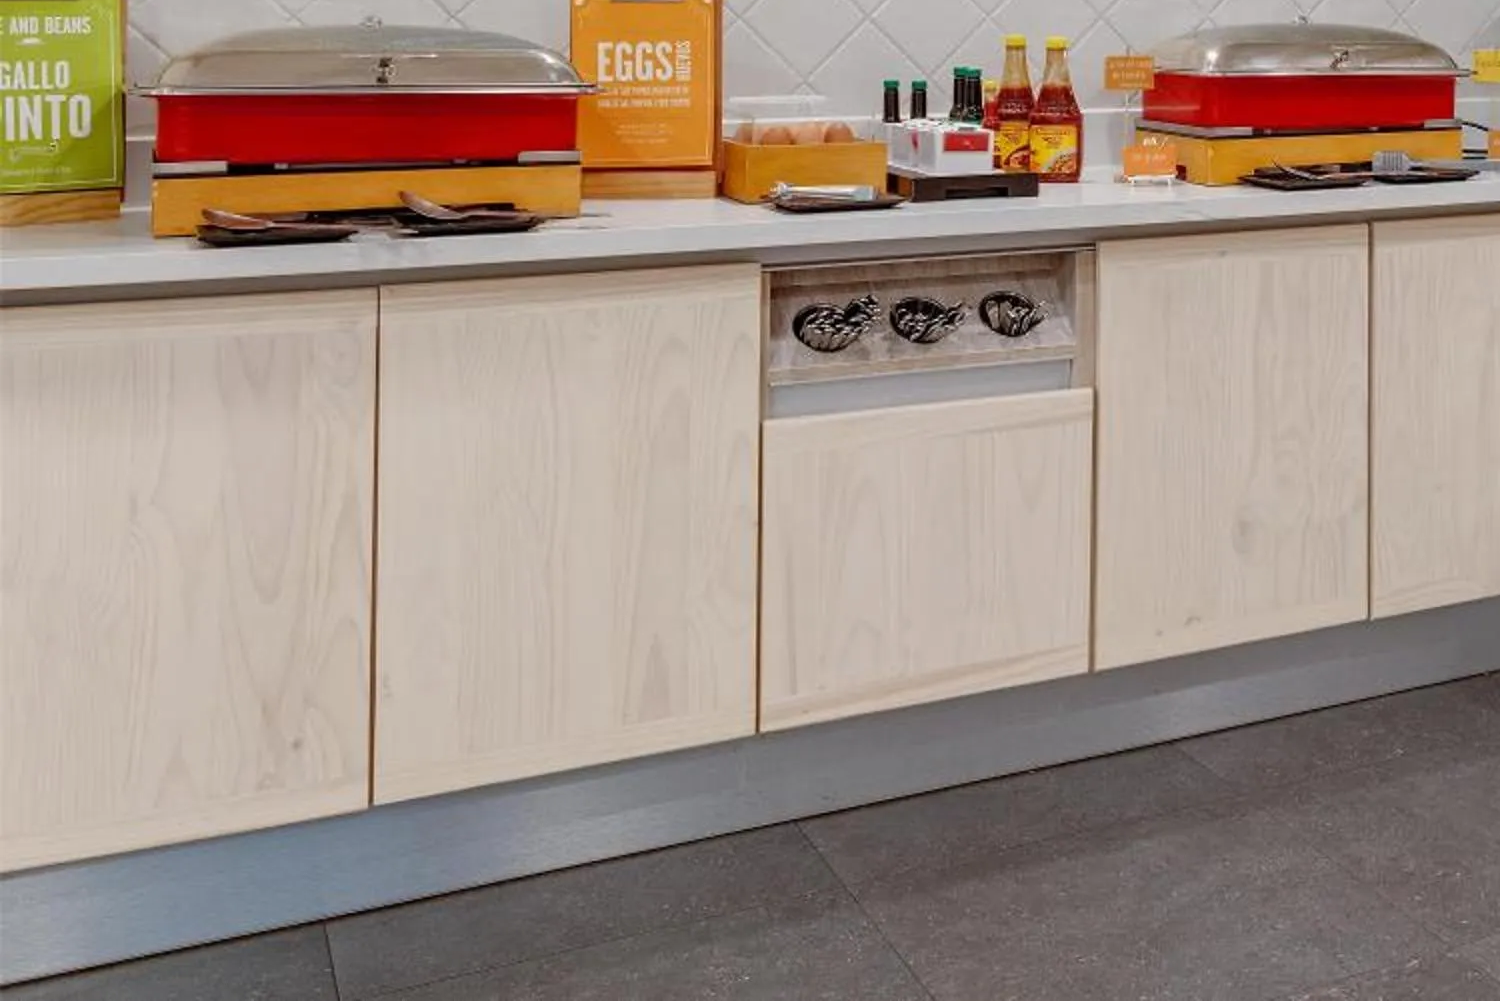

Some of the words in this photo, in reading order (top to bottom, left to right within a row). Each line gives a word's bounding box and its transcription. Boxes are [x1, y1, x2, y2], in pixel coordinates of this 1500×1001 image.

[10, 17, 39, 34] AND
[45, 16, 91, 34] BEANS
[0, 60, 70, 90] GALLO
[597, 40, 673, 82] EGGS
[0, 93, 92, 141] INTO
